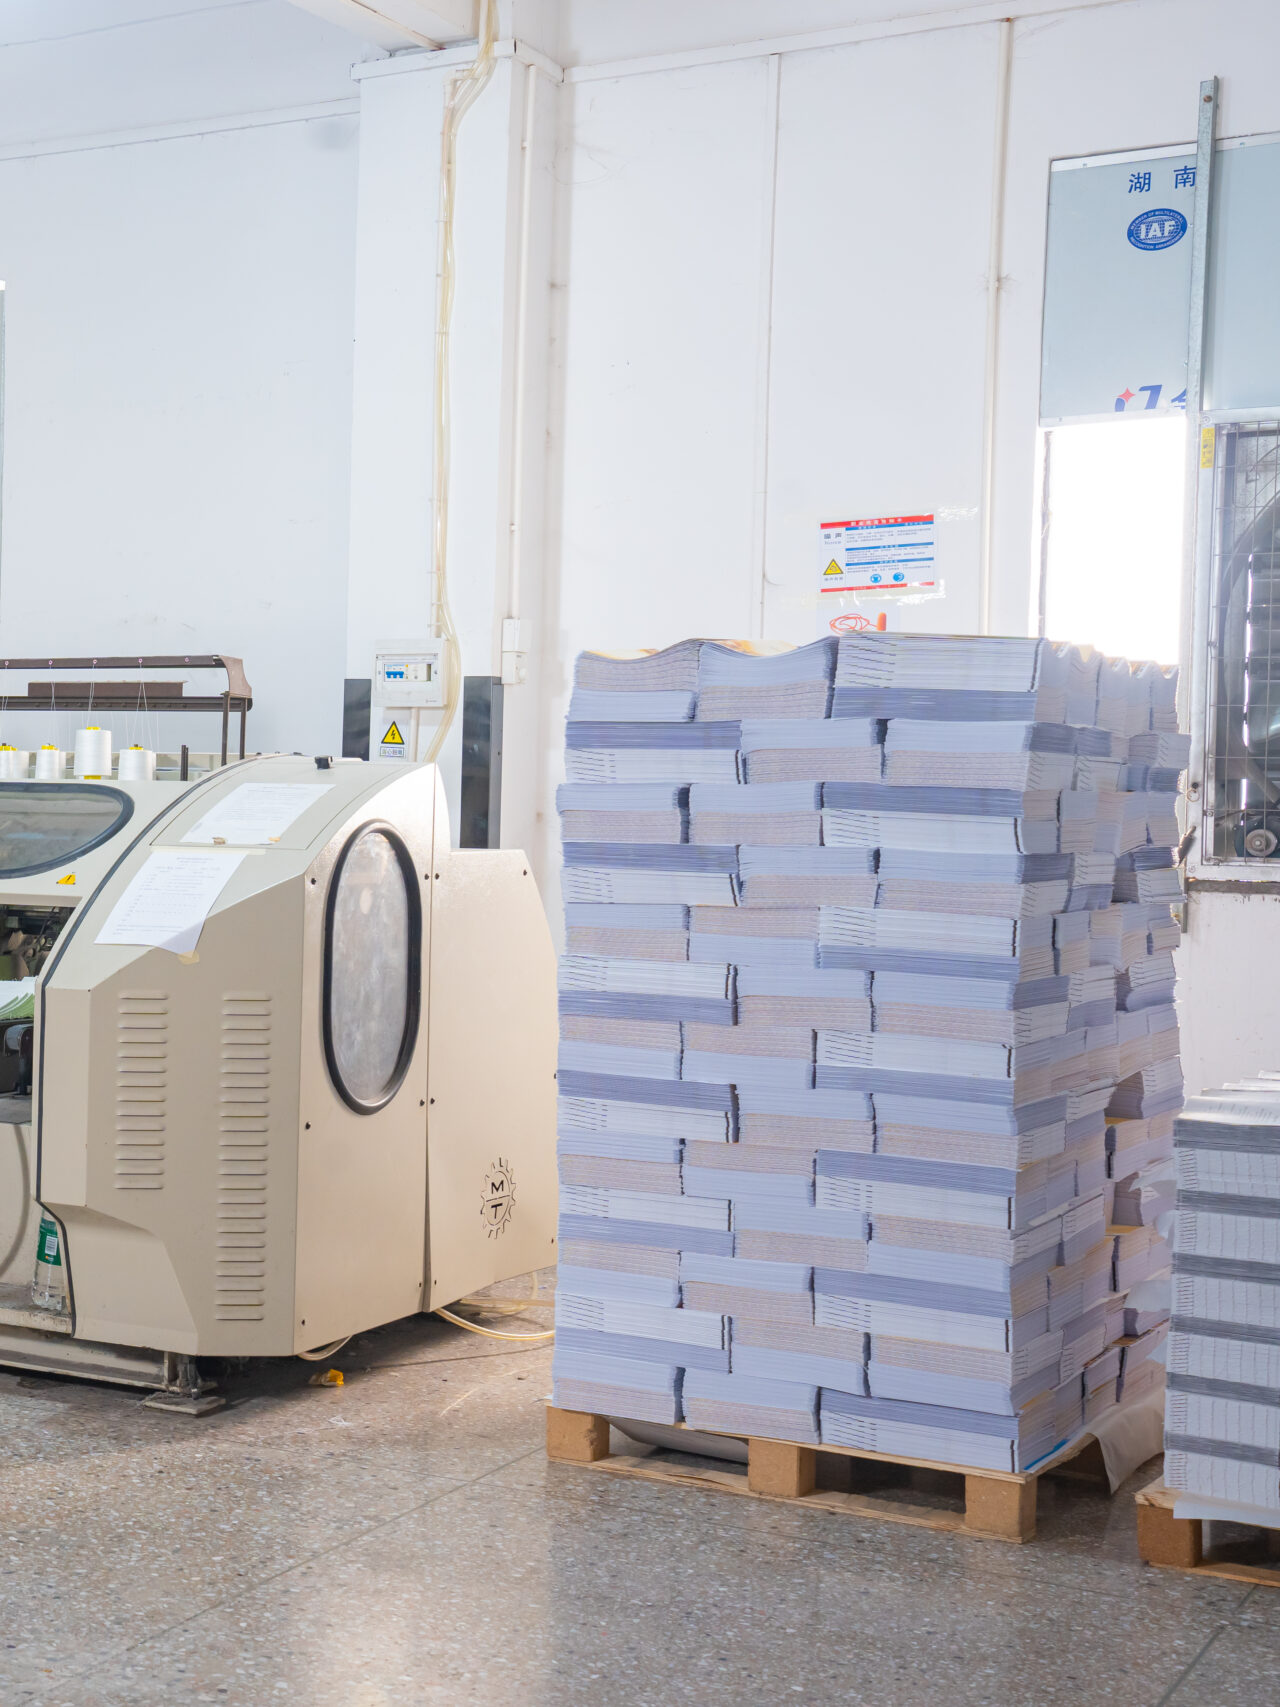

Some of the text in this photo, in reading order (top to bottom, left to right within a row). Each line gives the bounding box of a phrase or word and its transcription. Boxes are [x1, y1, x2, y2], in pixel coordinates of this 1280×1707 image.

[1128, 165, 1197, 193] 湖南
[1140, 221, 1176, 239] IAF
[491, 1180, 504, 1194] M
[491, 1203, 503, 1219] T
